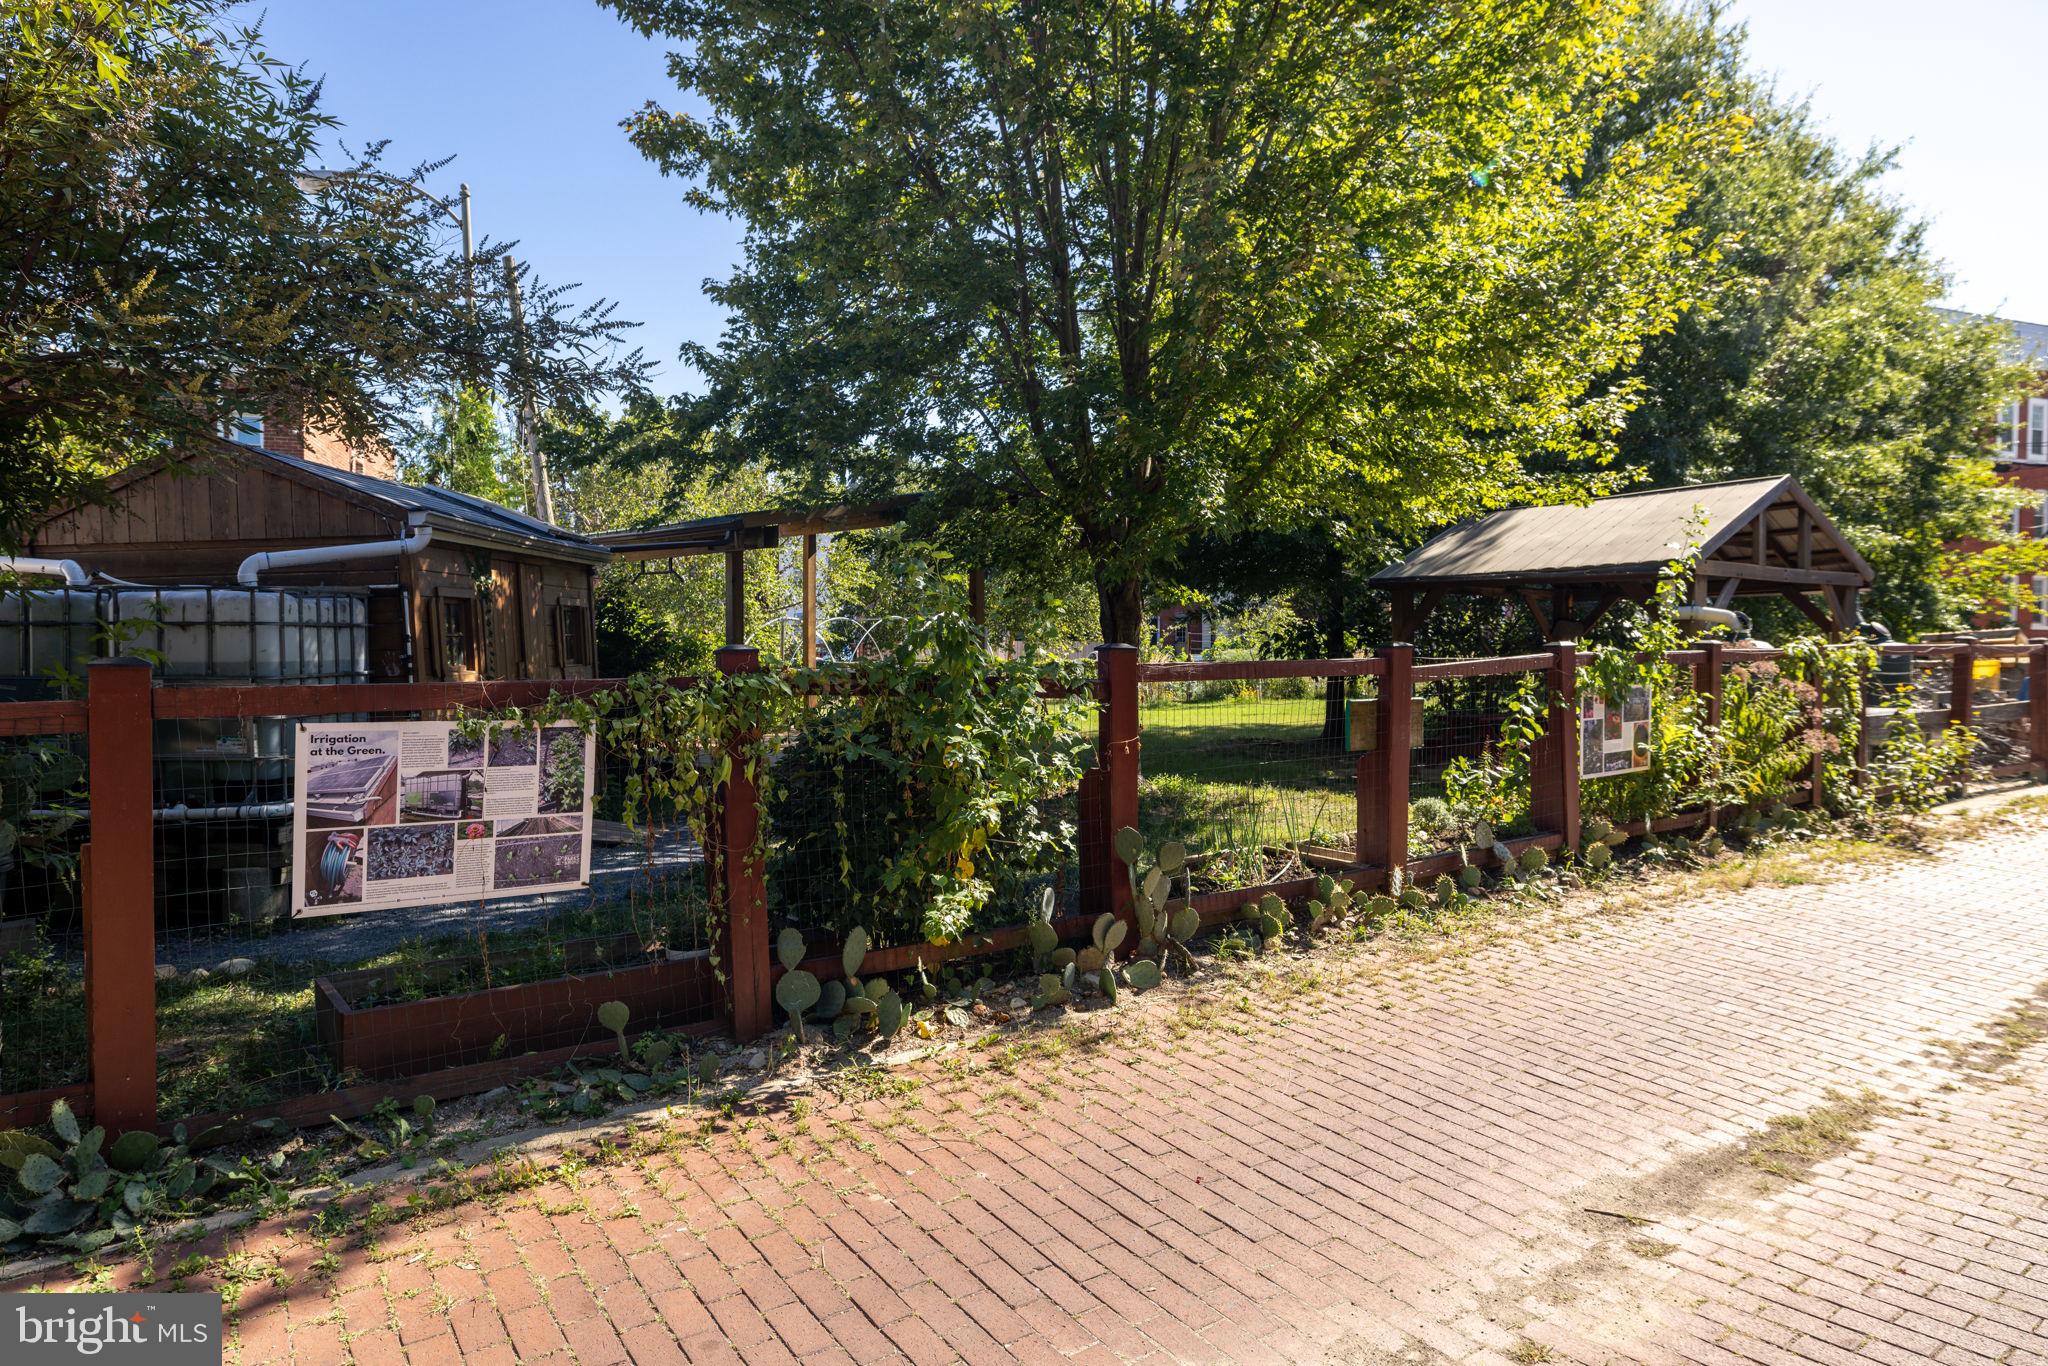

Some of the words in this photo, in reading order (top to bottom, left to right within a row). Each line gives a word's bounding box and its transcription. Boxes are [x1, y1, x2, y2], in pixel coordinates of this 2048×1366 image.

[310, 734, 367, 746] Irrigation
[310, 748, 322, 756] at
[325, 747, 344, 756] the
[347, 746, 386, 755] Green.
